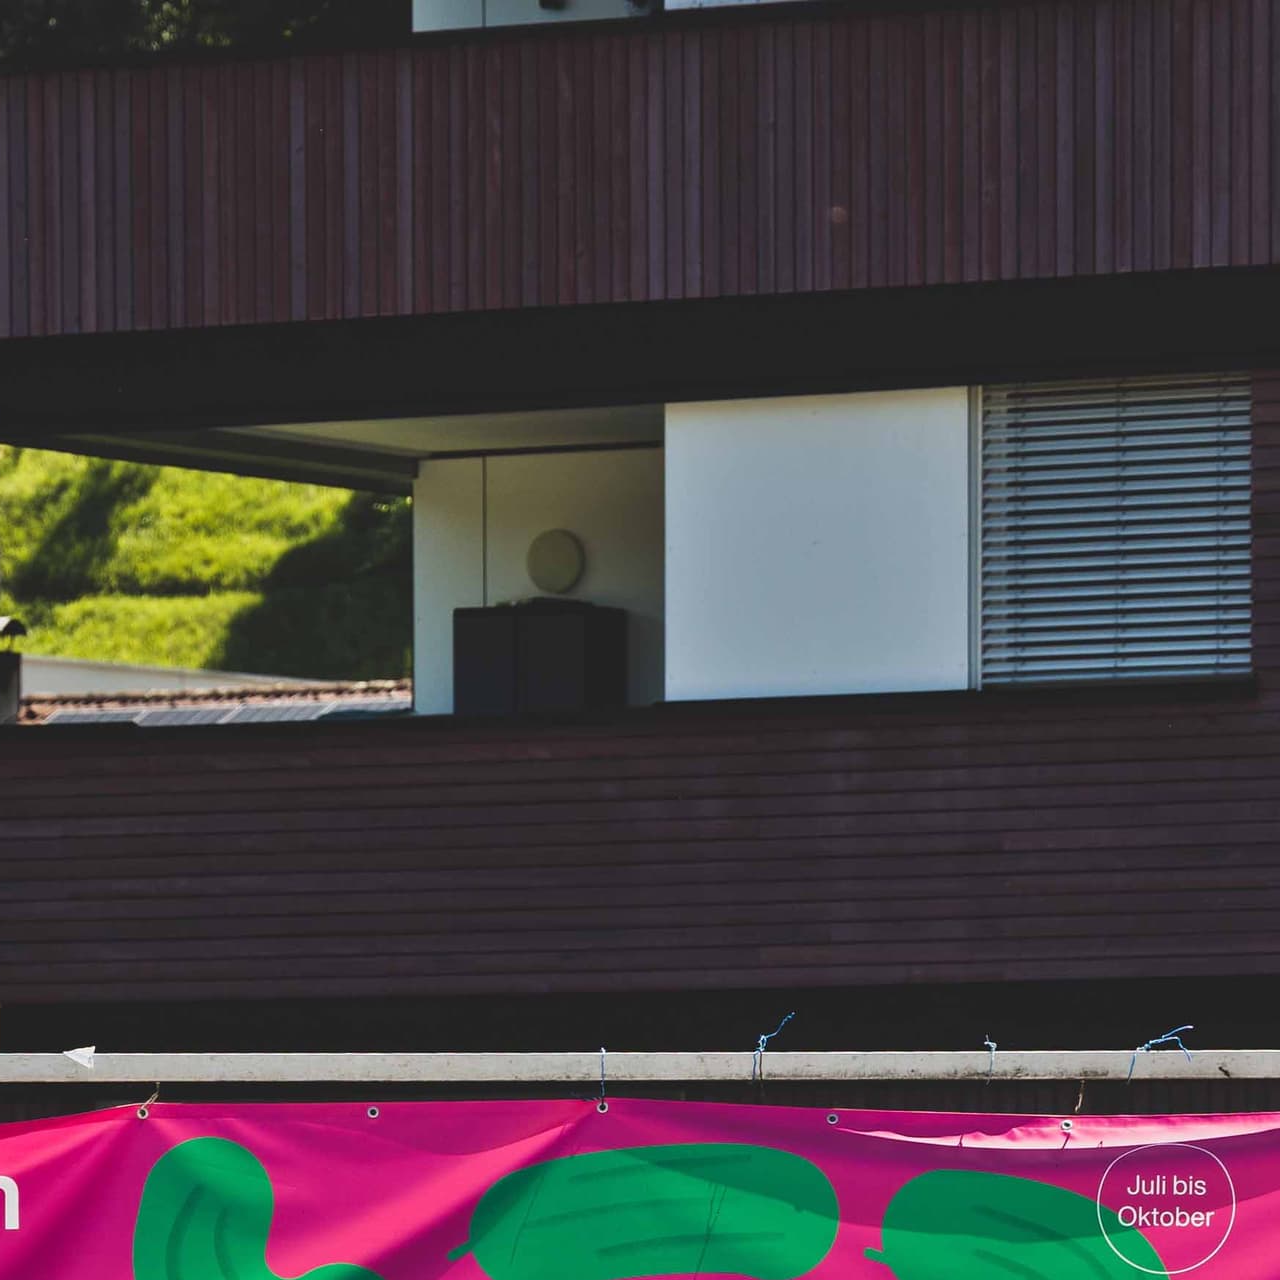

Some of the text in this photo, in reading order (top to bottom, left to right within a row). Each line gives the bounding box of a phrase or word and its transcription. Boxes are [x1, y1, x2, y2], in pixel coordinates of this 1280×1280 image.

[1127, 1174, 1207, 1196] Juli bis
[1117, 1205, 1215, 1228] Oktober
